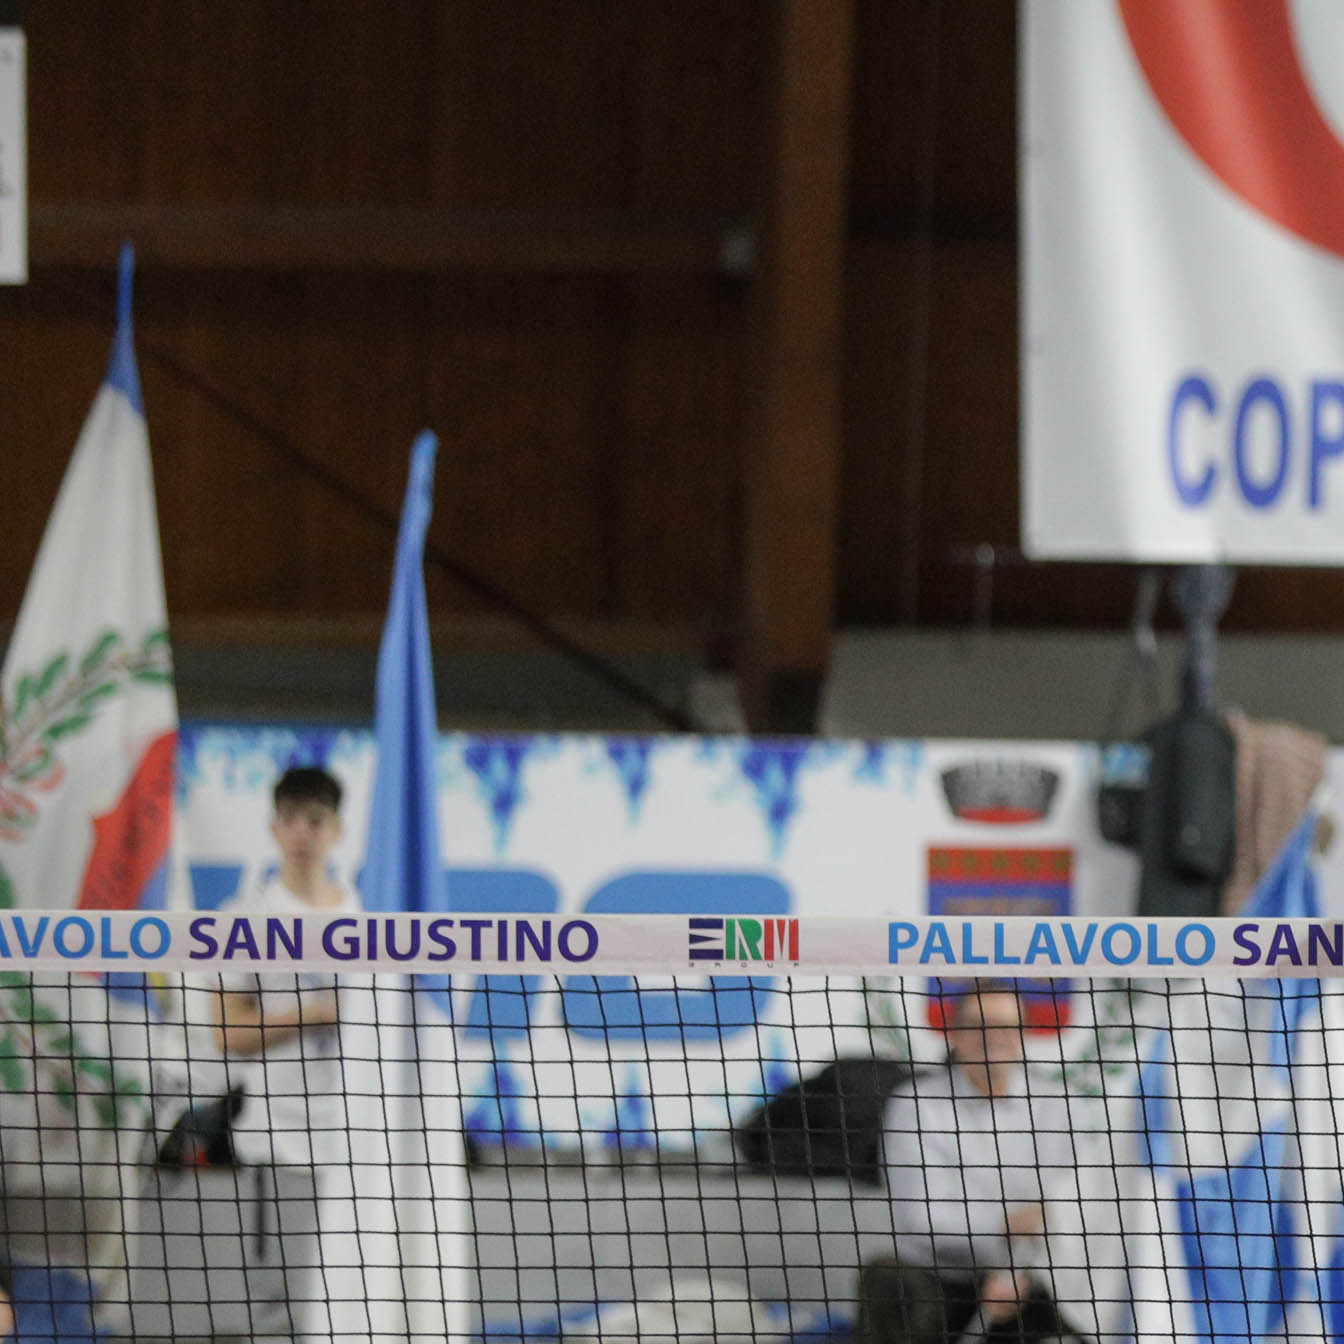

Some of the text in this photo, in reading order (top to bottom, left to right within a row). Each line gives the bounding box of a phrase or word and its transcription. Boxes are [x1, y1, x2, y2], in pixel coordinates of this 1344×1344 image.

[189, 916, 304, 963] SAN
[322, 917, 600, 964] GIUSTINO
[887, 920, 1216, 966] PALLAVOLO
[1232, 921, 1344, 967] SAN
